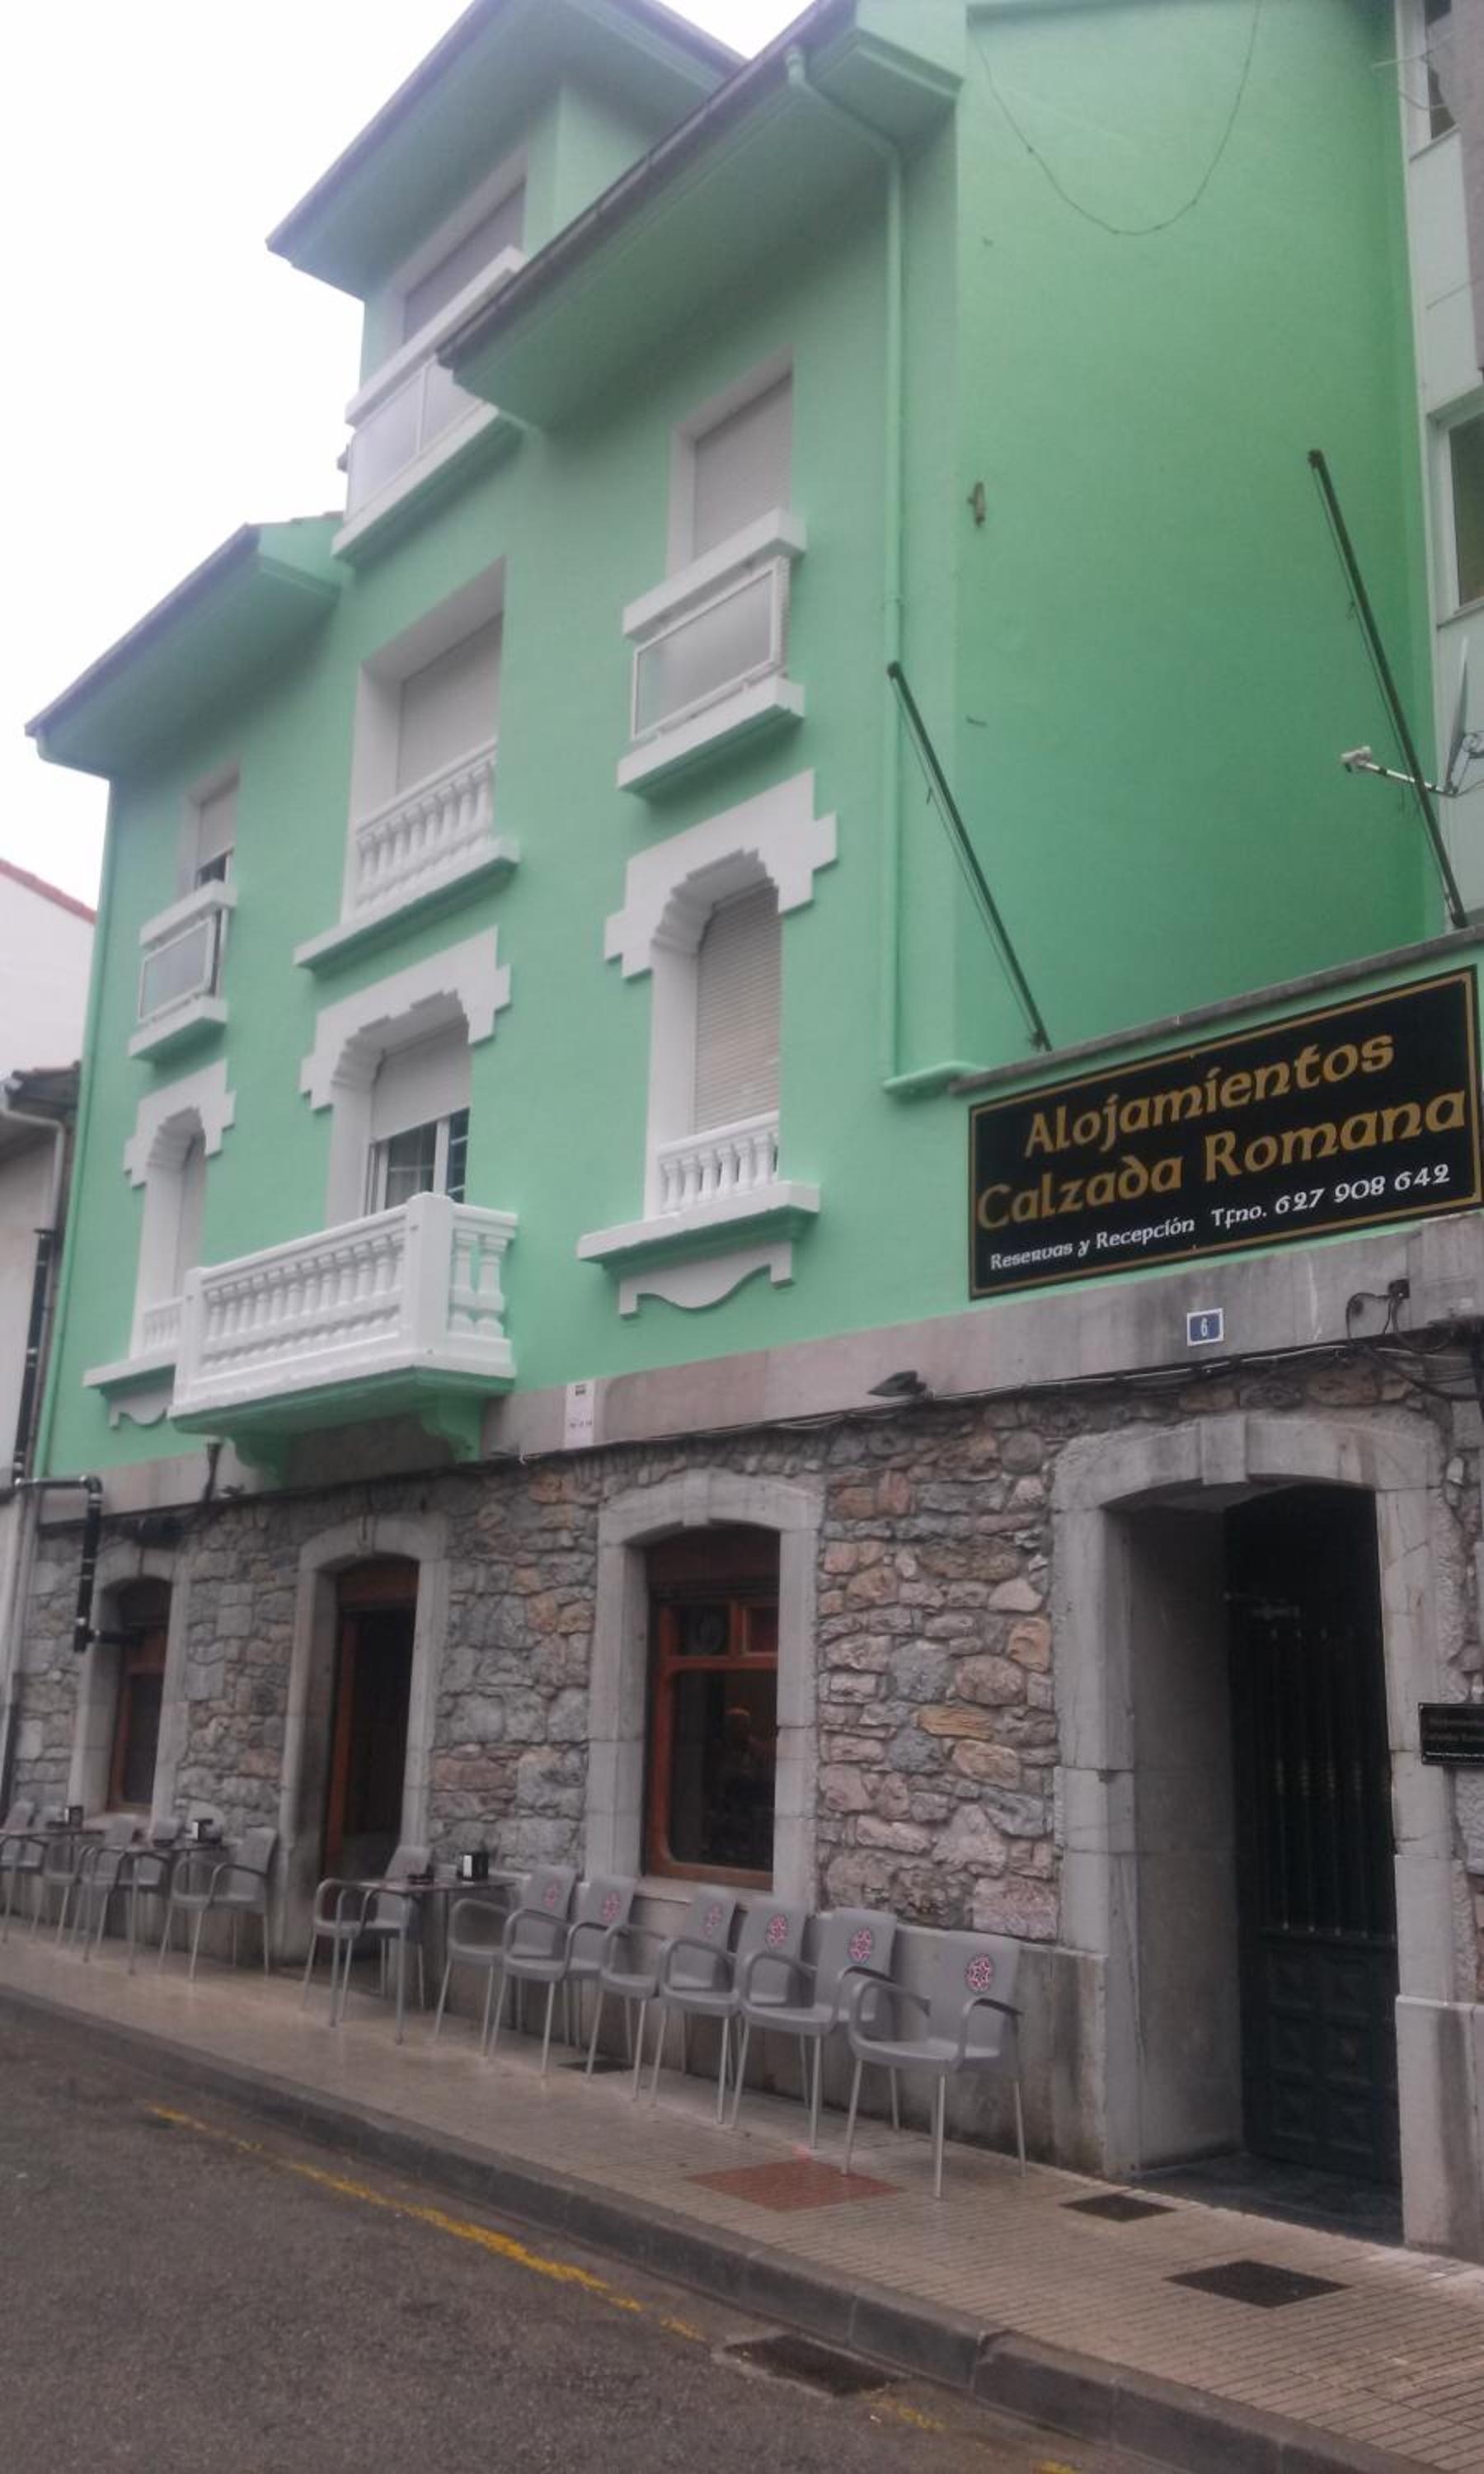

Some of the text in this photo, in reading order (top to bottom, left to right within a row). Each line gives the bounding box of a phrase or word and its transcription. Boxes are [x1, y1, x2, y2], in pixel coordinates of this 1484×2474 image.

[1025, 1034, 1393, 1157] Alojamientos
[977, 1089, 1466, 1229] Calzada Romana
[990, 1164, 1451, 1270] Reservas y Recepción Tfno. 627 908 642
[1200, 1317, 1209, 1337] 6
